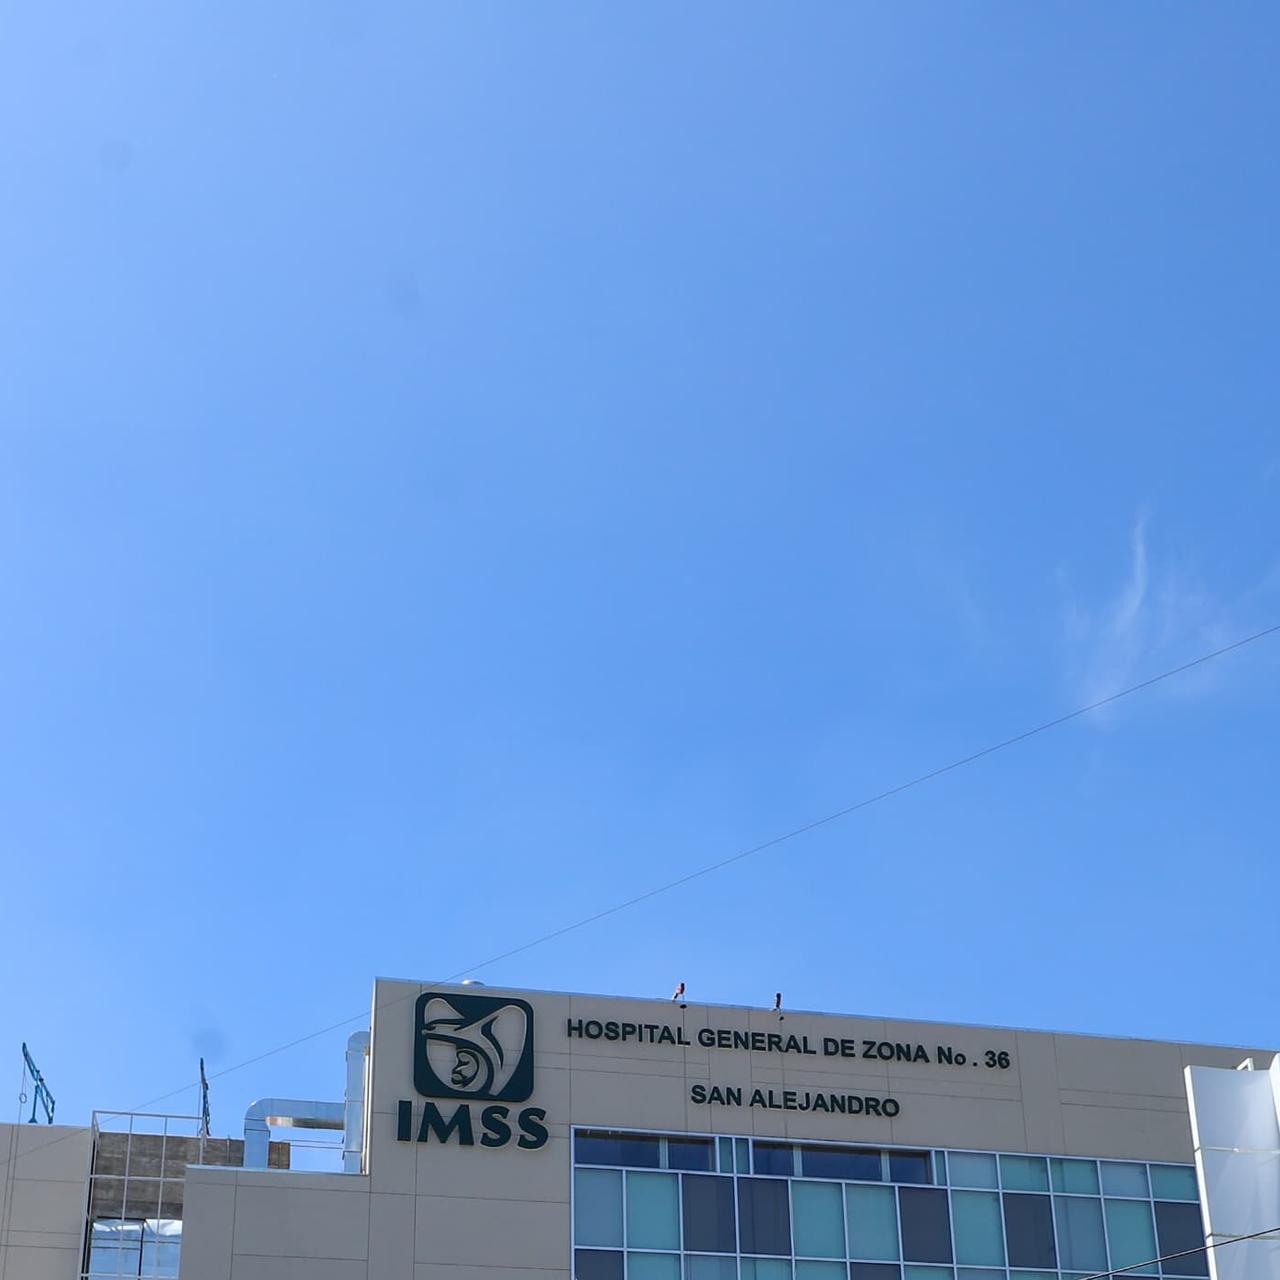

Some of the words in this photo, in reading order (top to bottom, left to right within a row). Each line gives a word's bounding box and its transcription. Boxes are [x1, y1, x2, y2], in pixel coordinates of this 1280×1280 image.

[567, 1018, 690, 1046] HOSPITAL
[698, 1028, 816, 1055] GENERAL
[823, 1037, 855, 1057] DE
[862, 1040, 930, 1063] ZONA
[985, 1050, 1010, 1069] 36
[397, 1100, 549, 1149] IMSS
[691, 1084, 741, 1106] SAN
[749, 1089, 899, 1117] ALEJANDRO
